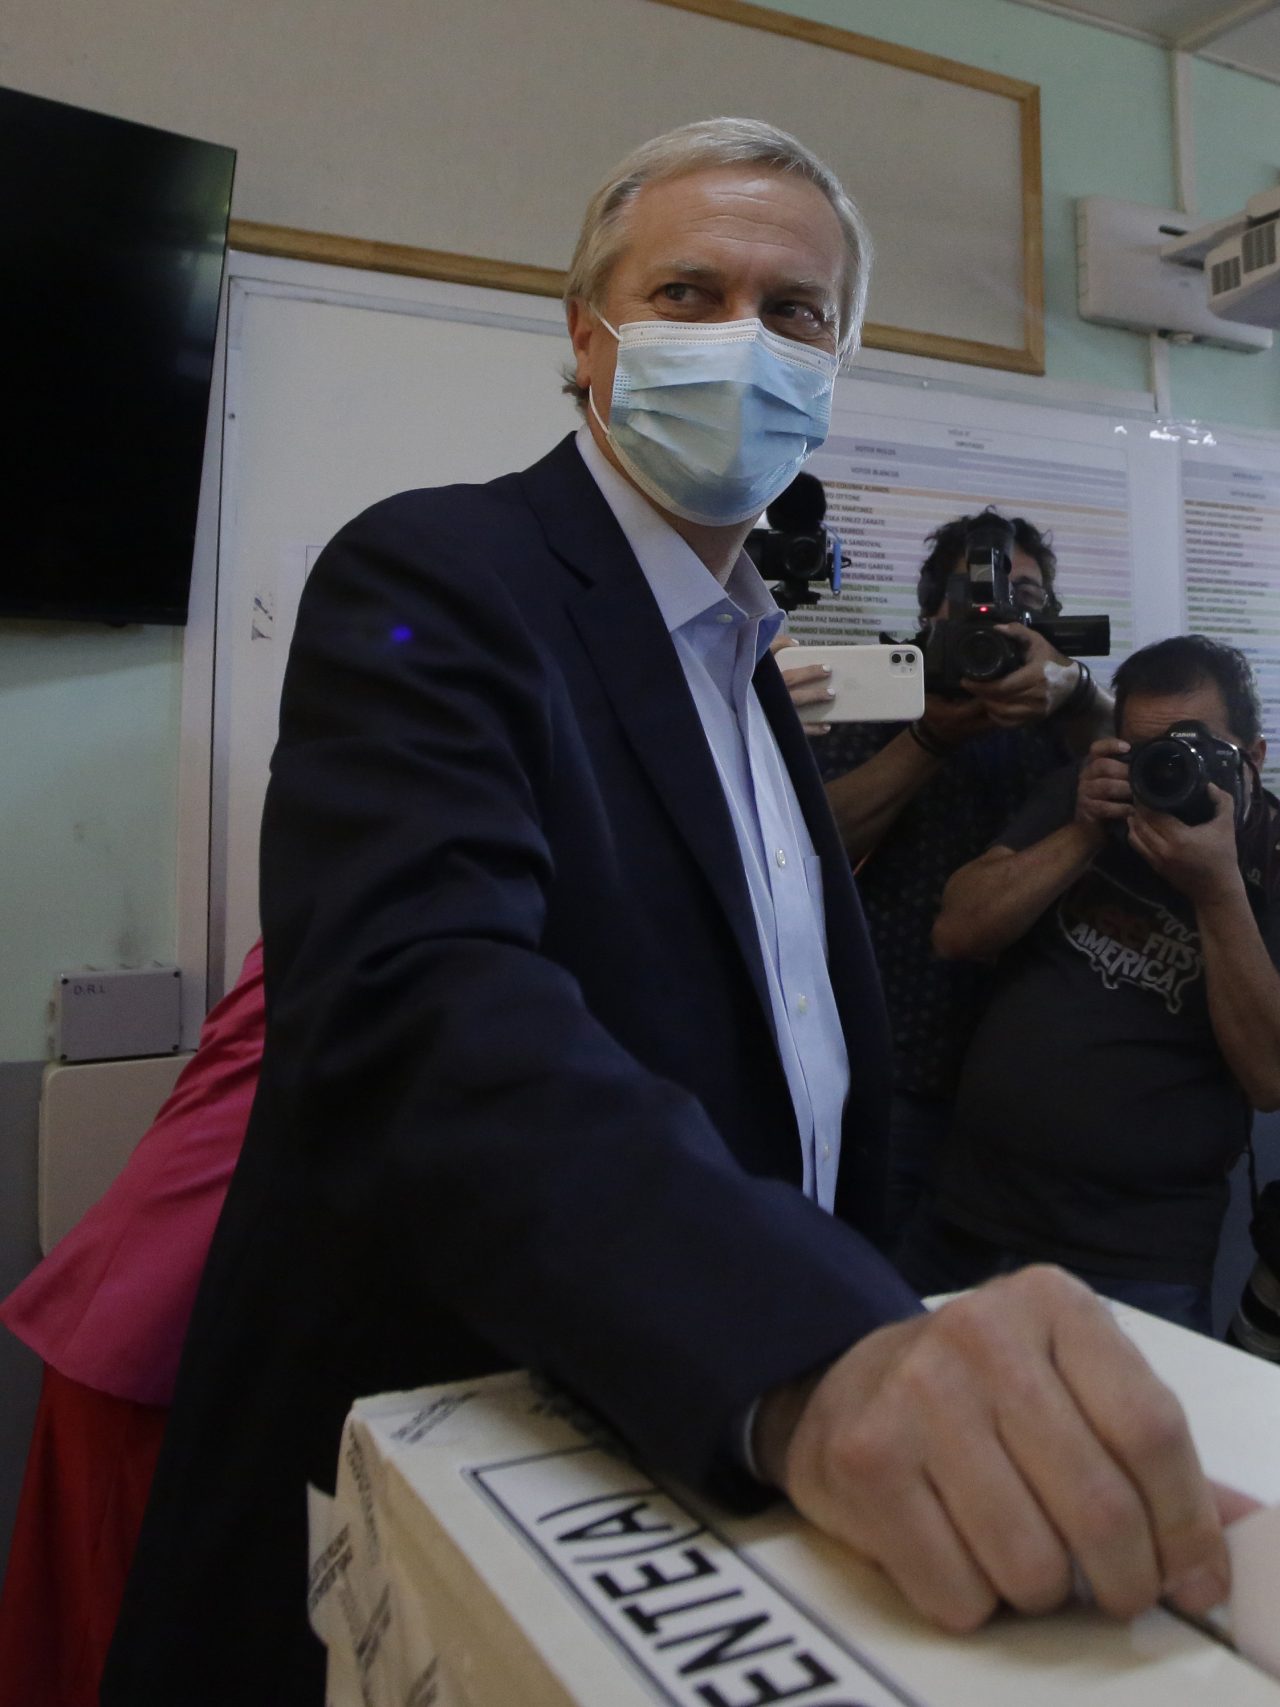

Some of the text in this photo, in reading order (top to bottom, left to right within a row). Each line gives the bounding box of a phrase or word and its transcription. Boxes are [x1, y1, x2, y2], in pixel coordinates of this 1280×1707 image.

[1071, 922, 1177, 991] AMERICA
[1142, 932, 1197, 970] FITS
[537, 1488, 850, 1707] ENTE(A)
